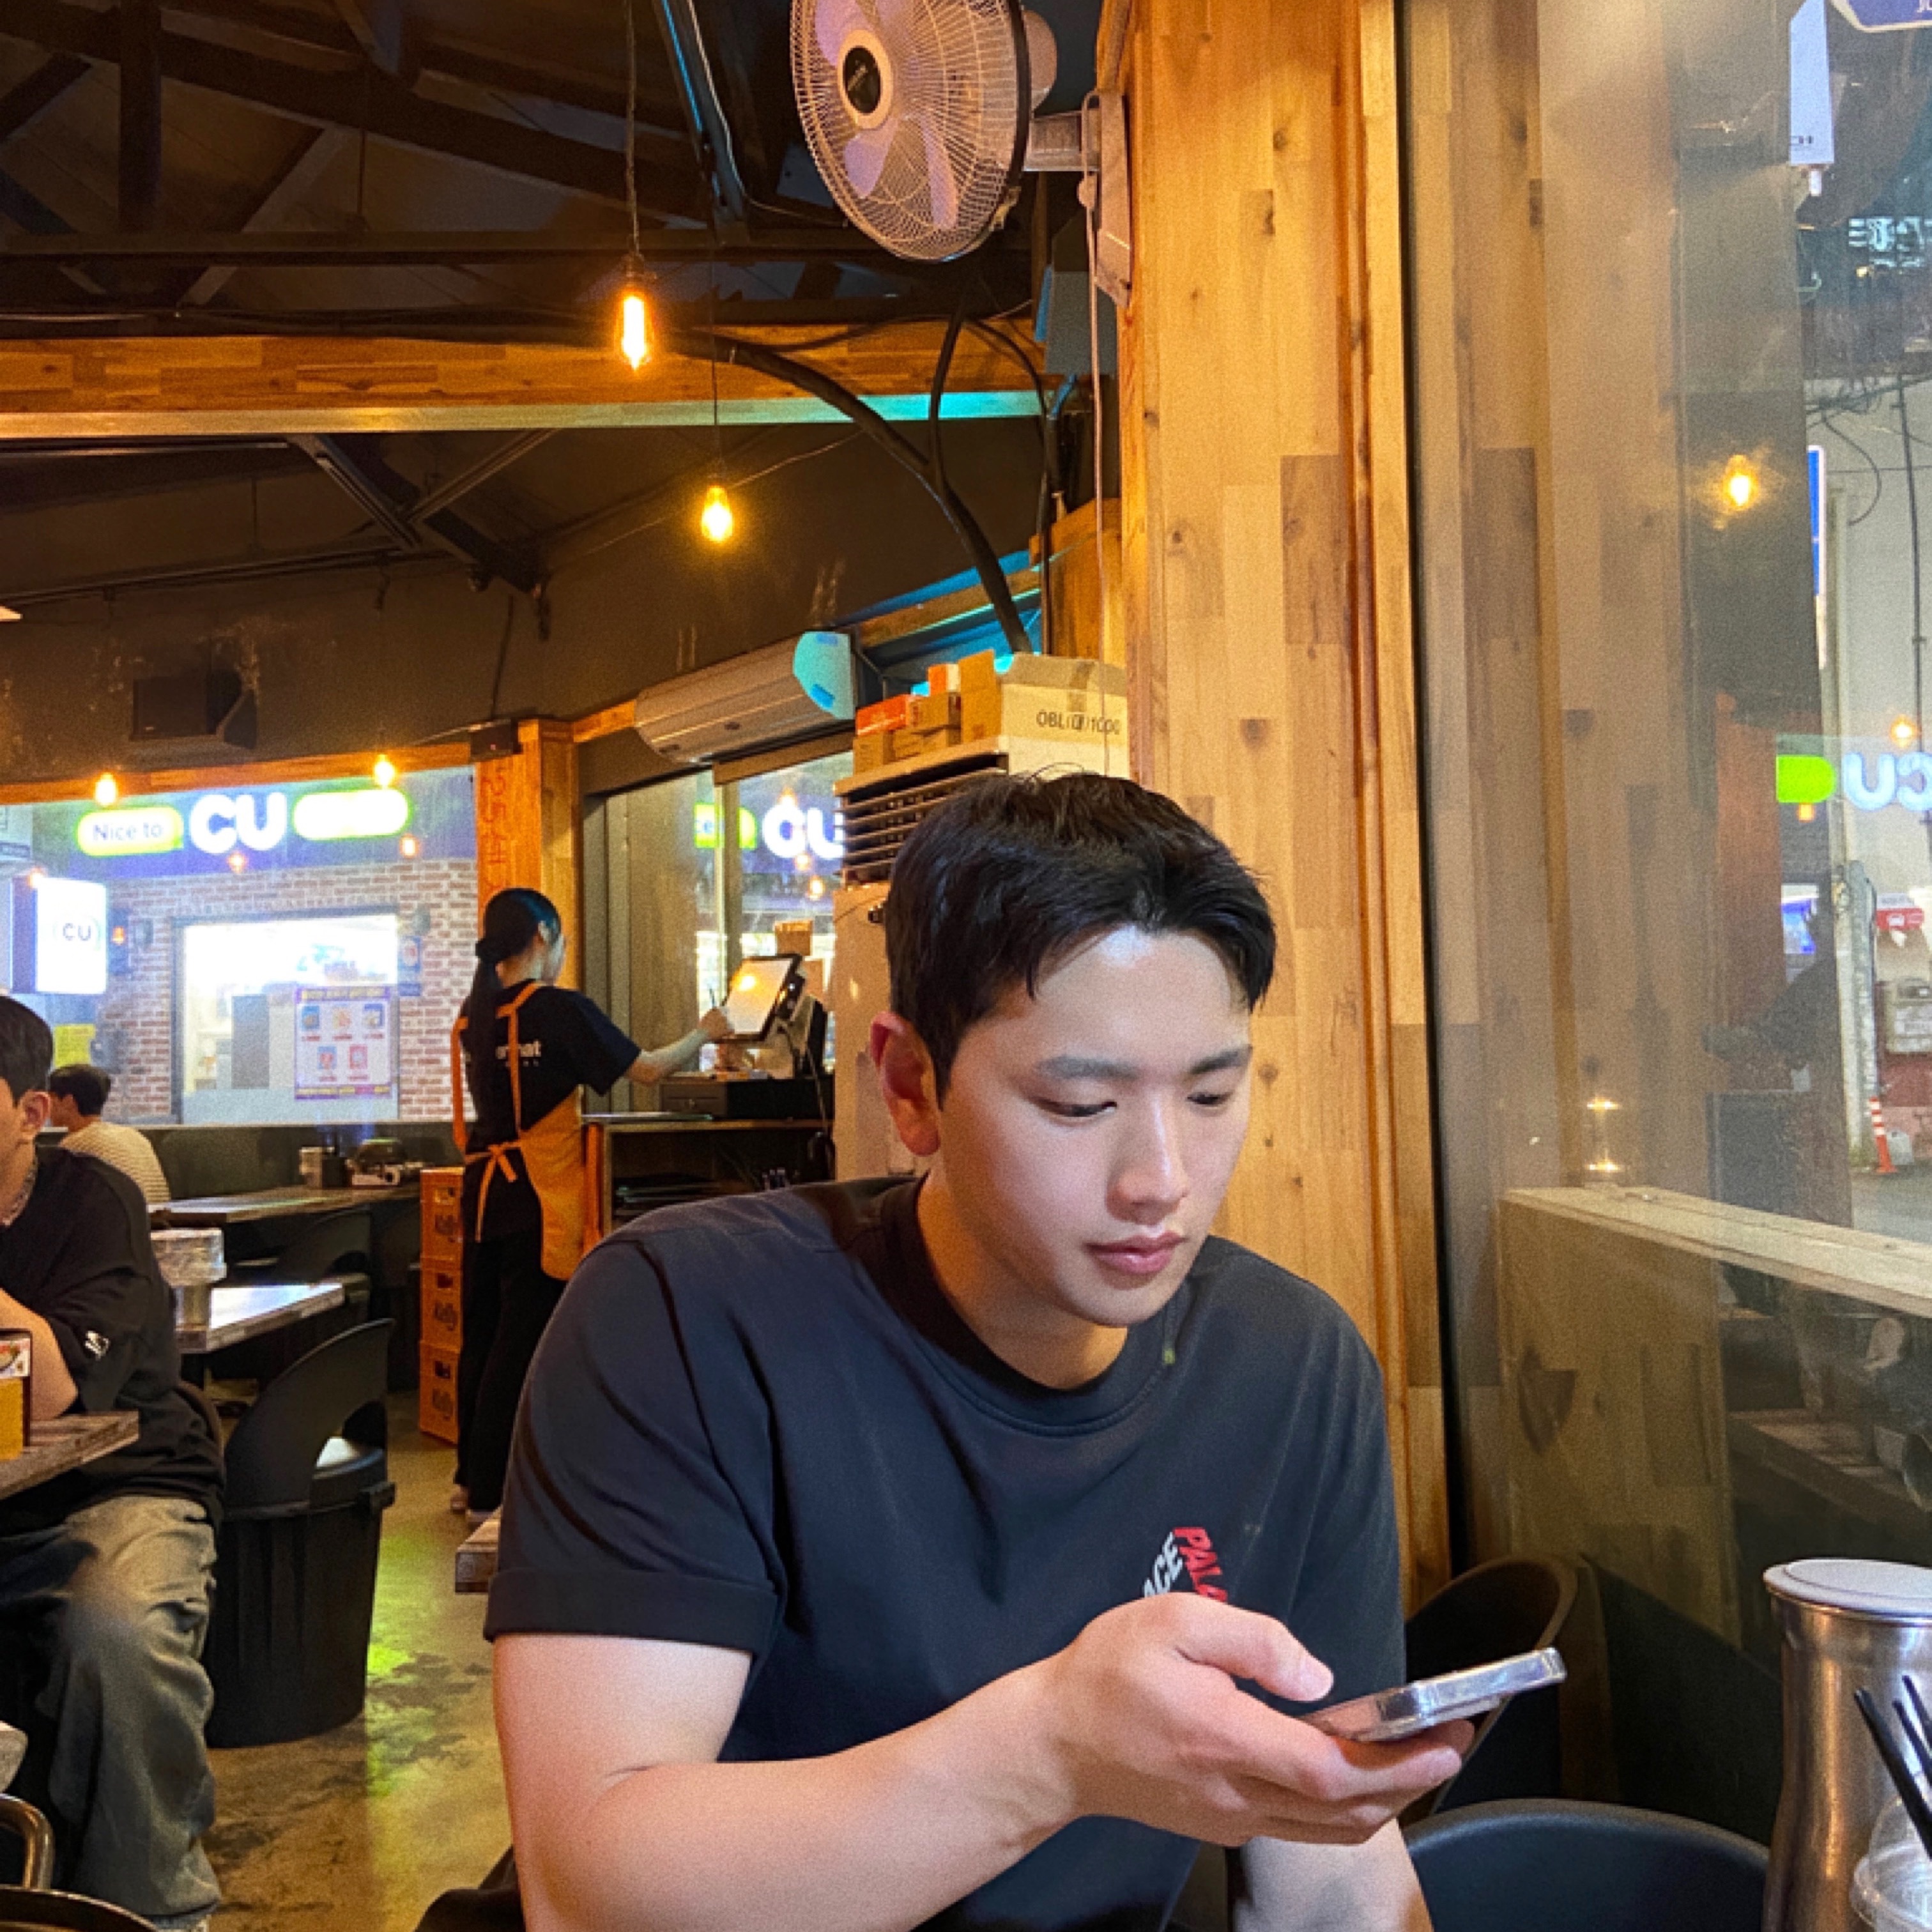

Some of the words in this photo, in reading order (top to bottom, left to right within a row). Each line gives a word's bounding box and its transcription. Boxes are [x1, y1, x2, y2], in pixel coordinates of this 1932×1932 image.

[93, 824, 137, 841] Nice
[142, 822, 163, 838] to
[190, 792, 288, 854] CU
[63, 923, 91, 941] CU
[1173, 1526, 1229, 1602] PALA
